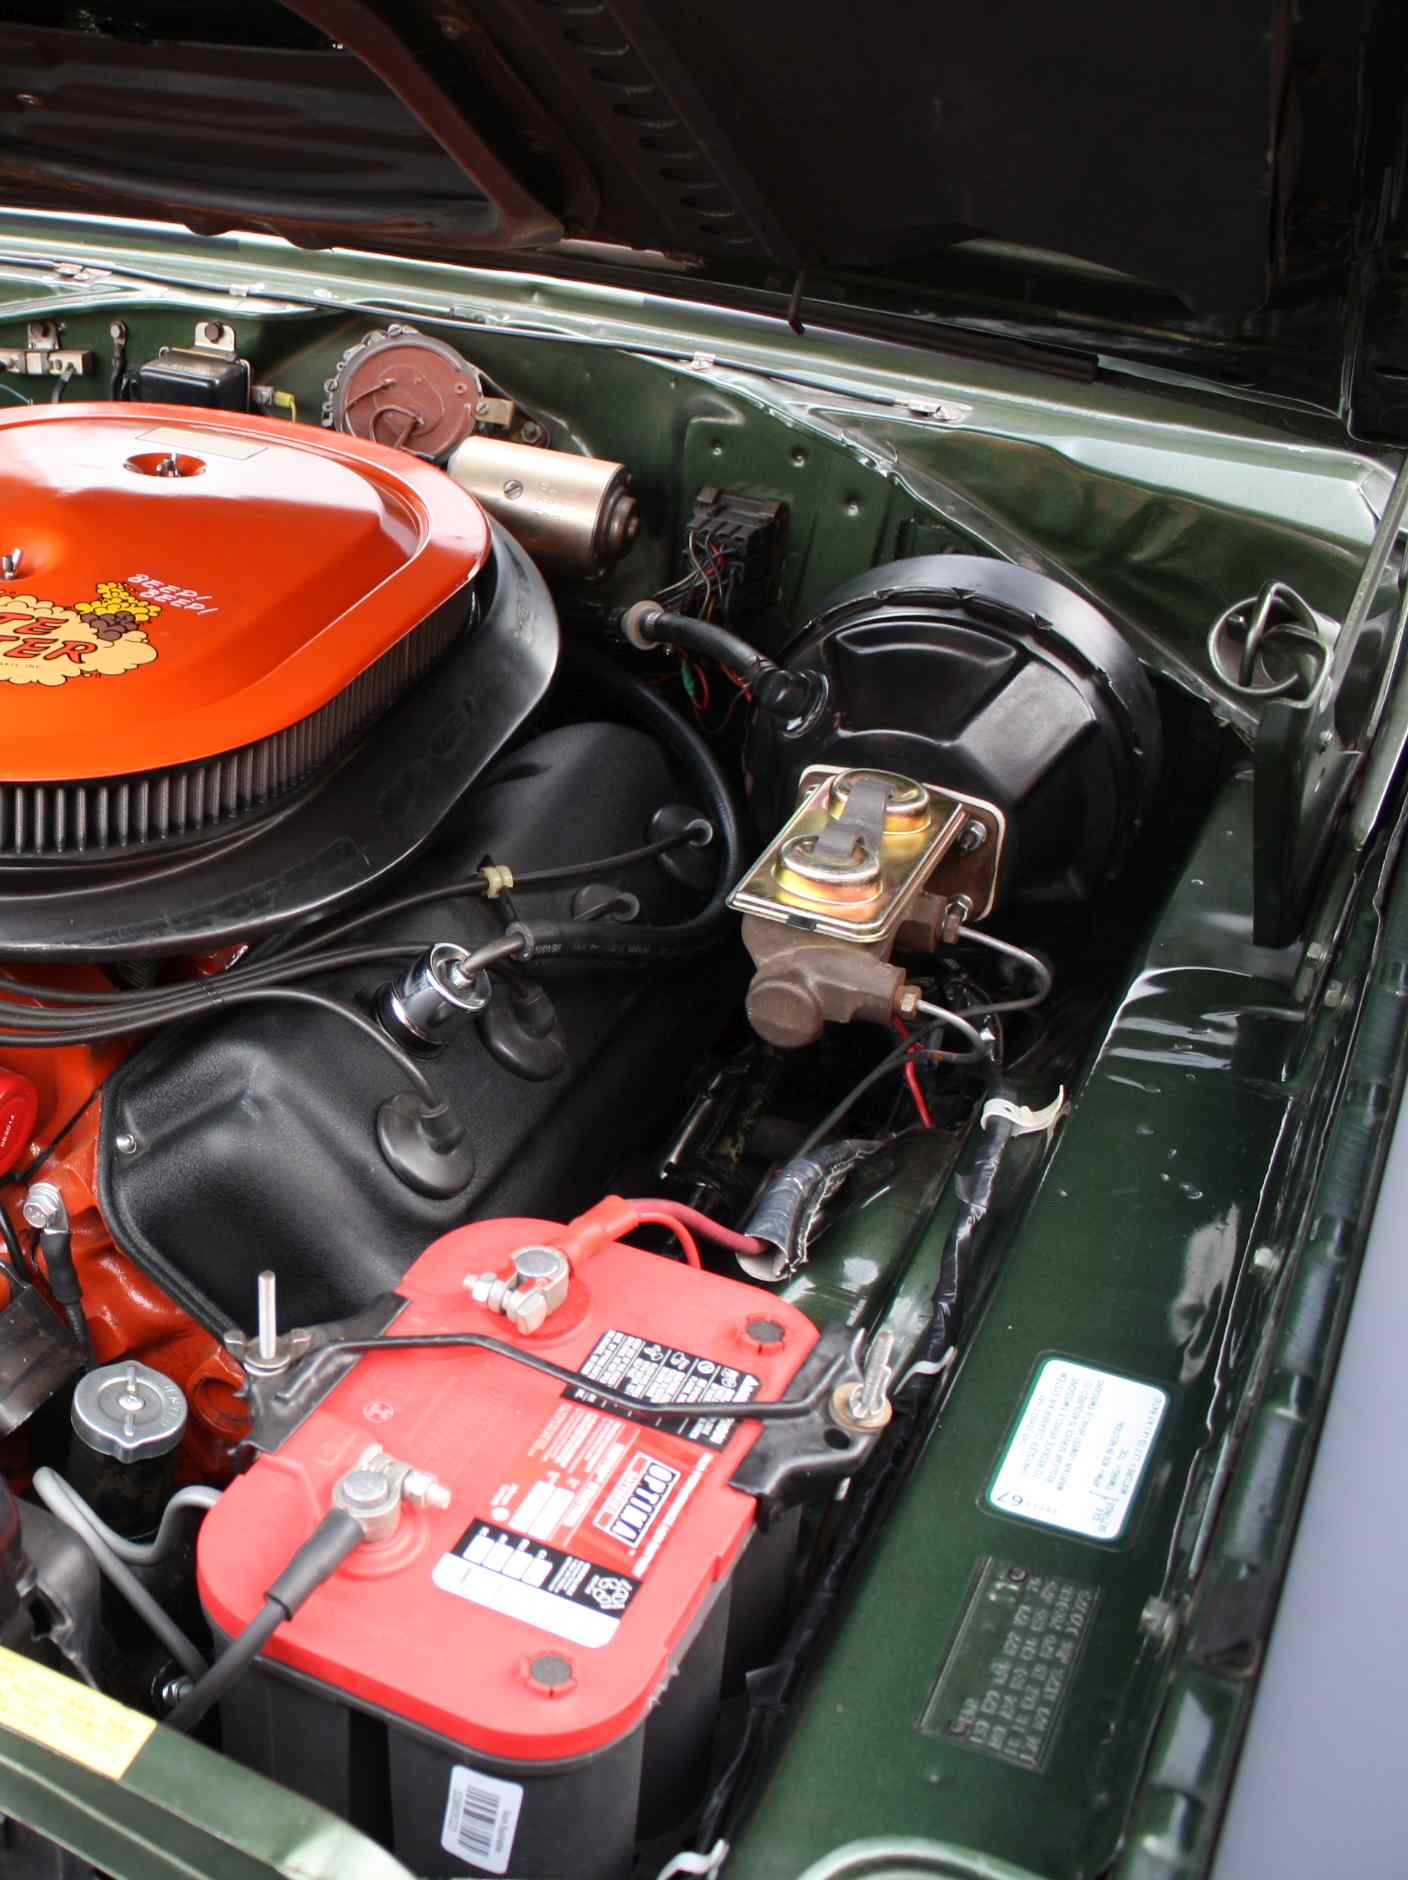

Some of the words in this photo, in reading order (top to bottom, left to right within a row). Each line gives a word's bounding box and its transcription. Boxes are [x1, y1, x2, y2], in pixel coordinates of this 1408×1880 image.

[127, 573, 213, 601] BEEP!
[139, 589, 219, 615] BEEP!
[609, 1463, 676, 1539] OPTIMA
